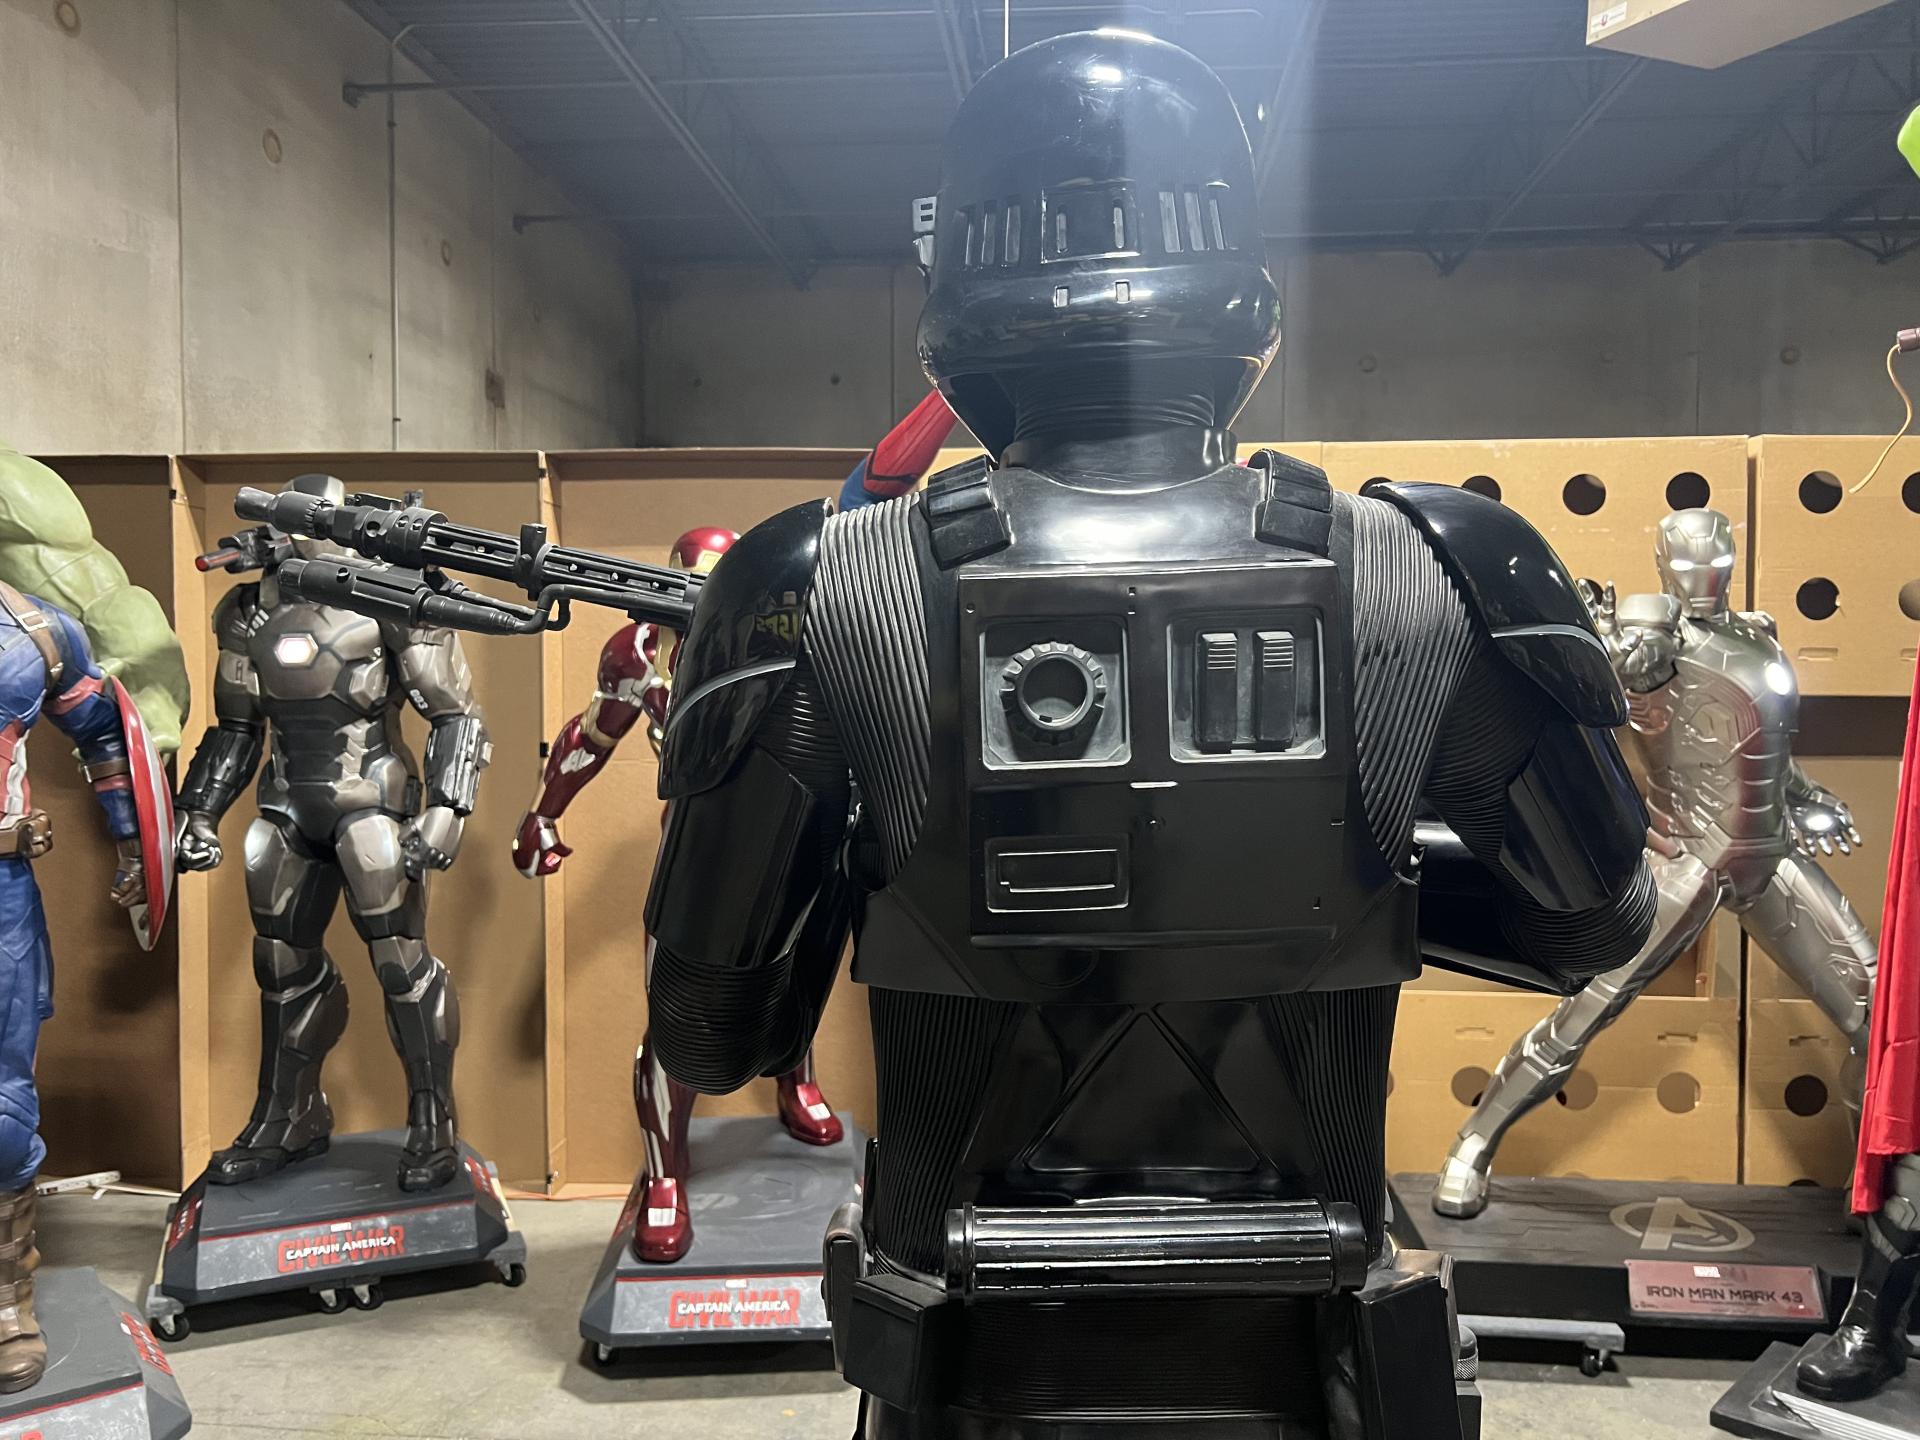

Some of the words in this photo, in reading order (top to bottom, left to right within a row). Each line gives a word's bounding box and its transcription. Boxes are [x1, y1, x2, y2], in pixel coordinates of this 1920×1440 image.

[286, 1243, 340, 1260] CAPTAIN
[341, 1236, 396, 1252] AMERICA
[1646, 1285, 1684, 1298] IRON
[1689, 1287, 1726, 1300] MAN
[1729, 1290, 1776, 1302] MARK
[1781, 1291, 1804, 1303] 43
[677, 1301, 733, 1315] CAPTAIN
[734, 1299, 791, 1313] AMERICA
